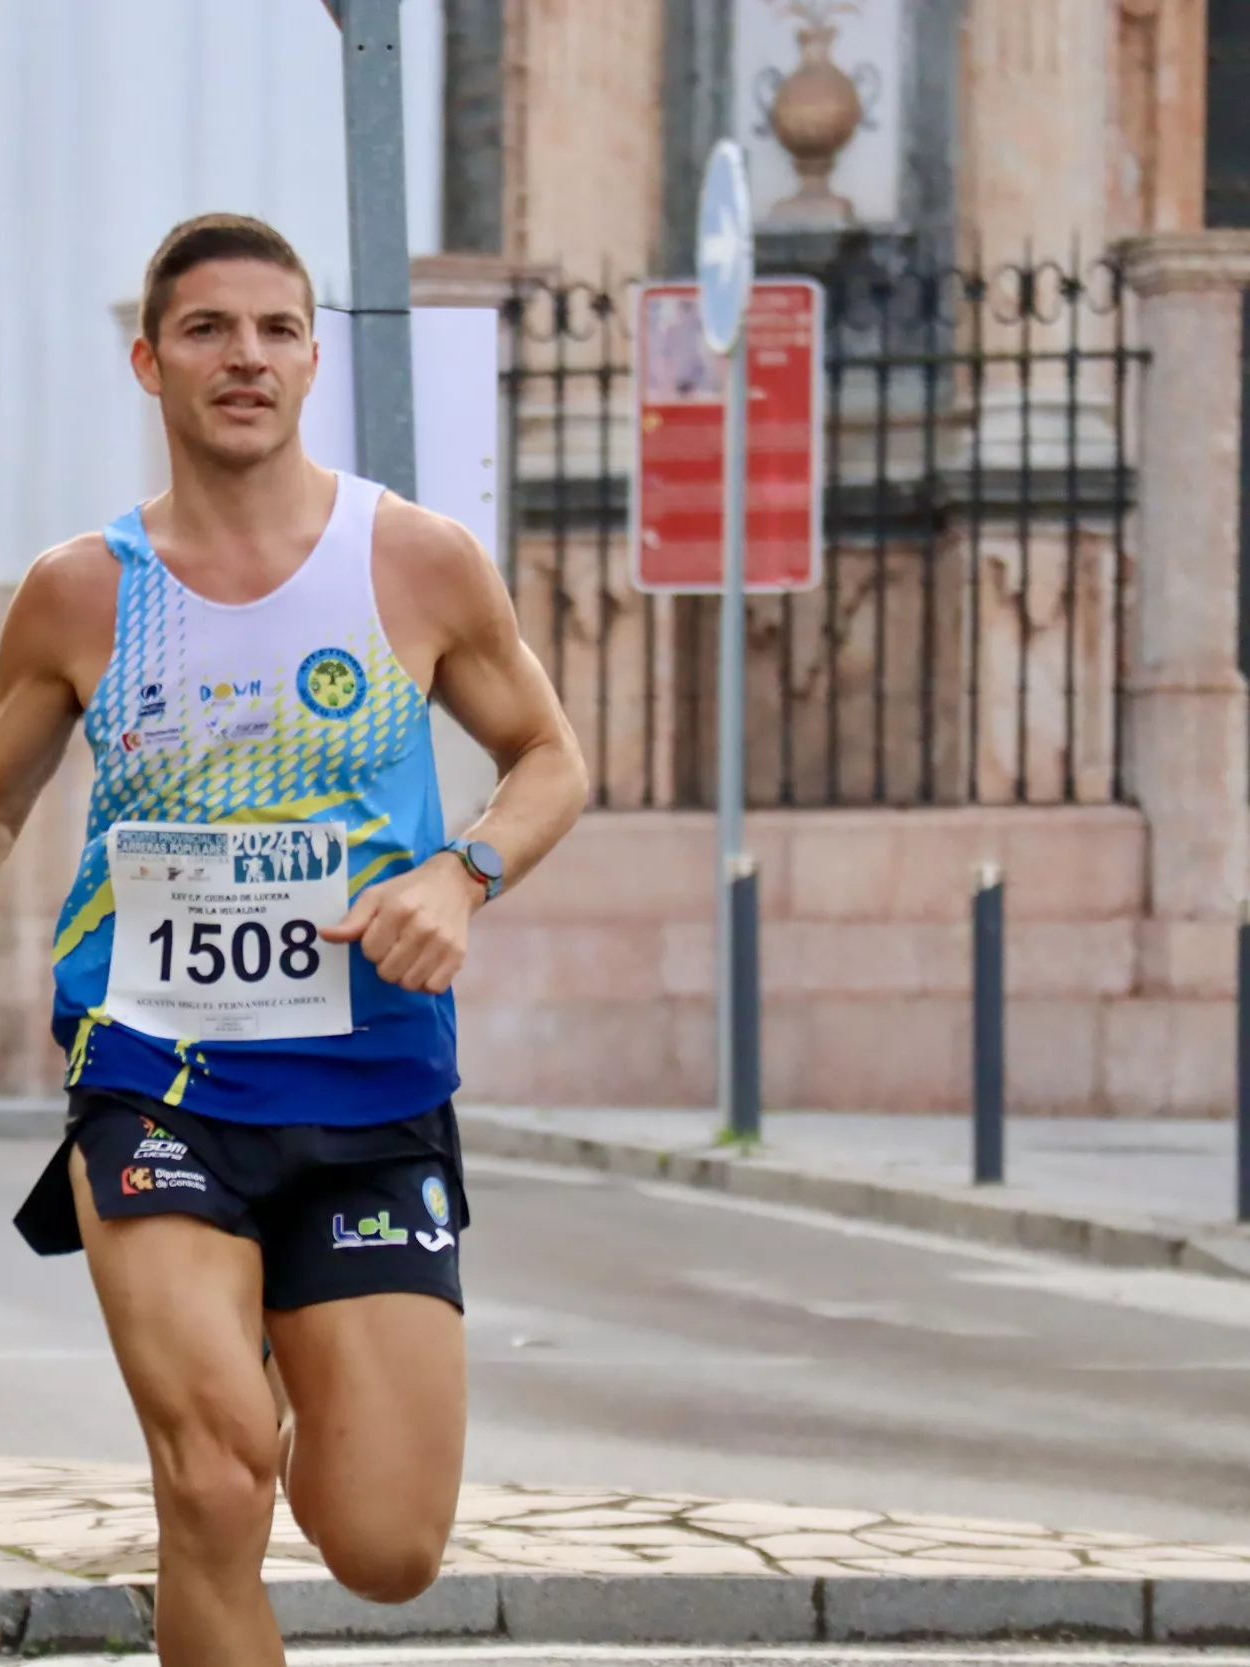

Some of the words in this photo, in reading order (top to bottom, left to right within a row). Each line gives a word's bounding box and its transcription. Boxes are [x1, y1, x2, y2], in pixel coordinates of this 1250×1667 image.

[231, 830, 290, 856] 2024
[205, 907, 217, 915] LA
[149, 919, 320, 985] 1508
[177, 1001, 214, 1010] MIGUEL
[279, 996, 327, 1007] CABRERA
